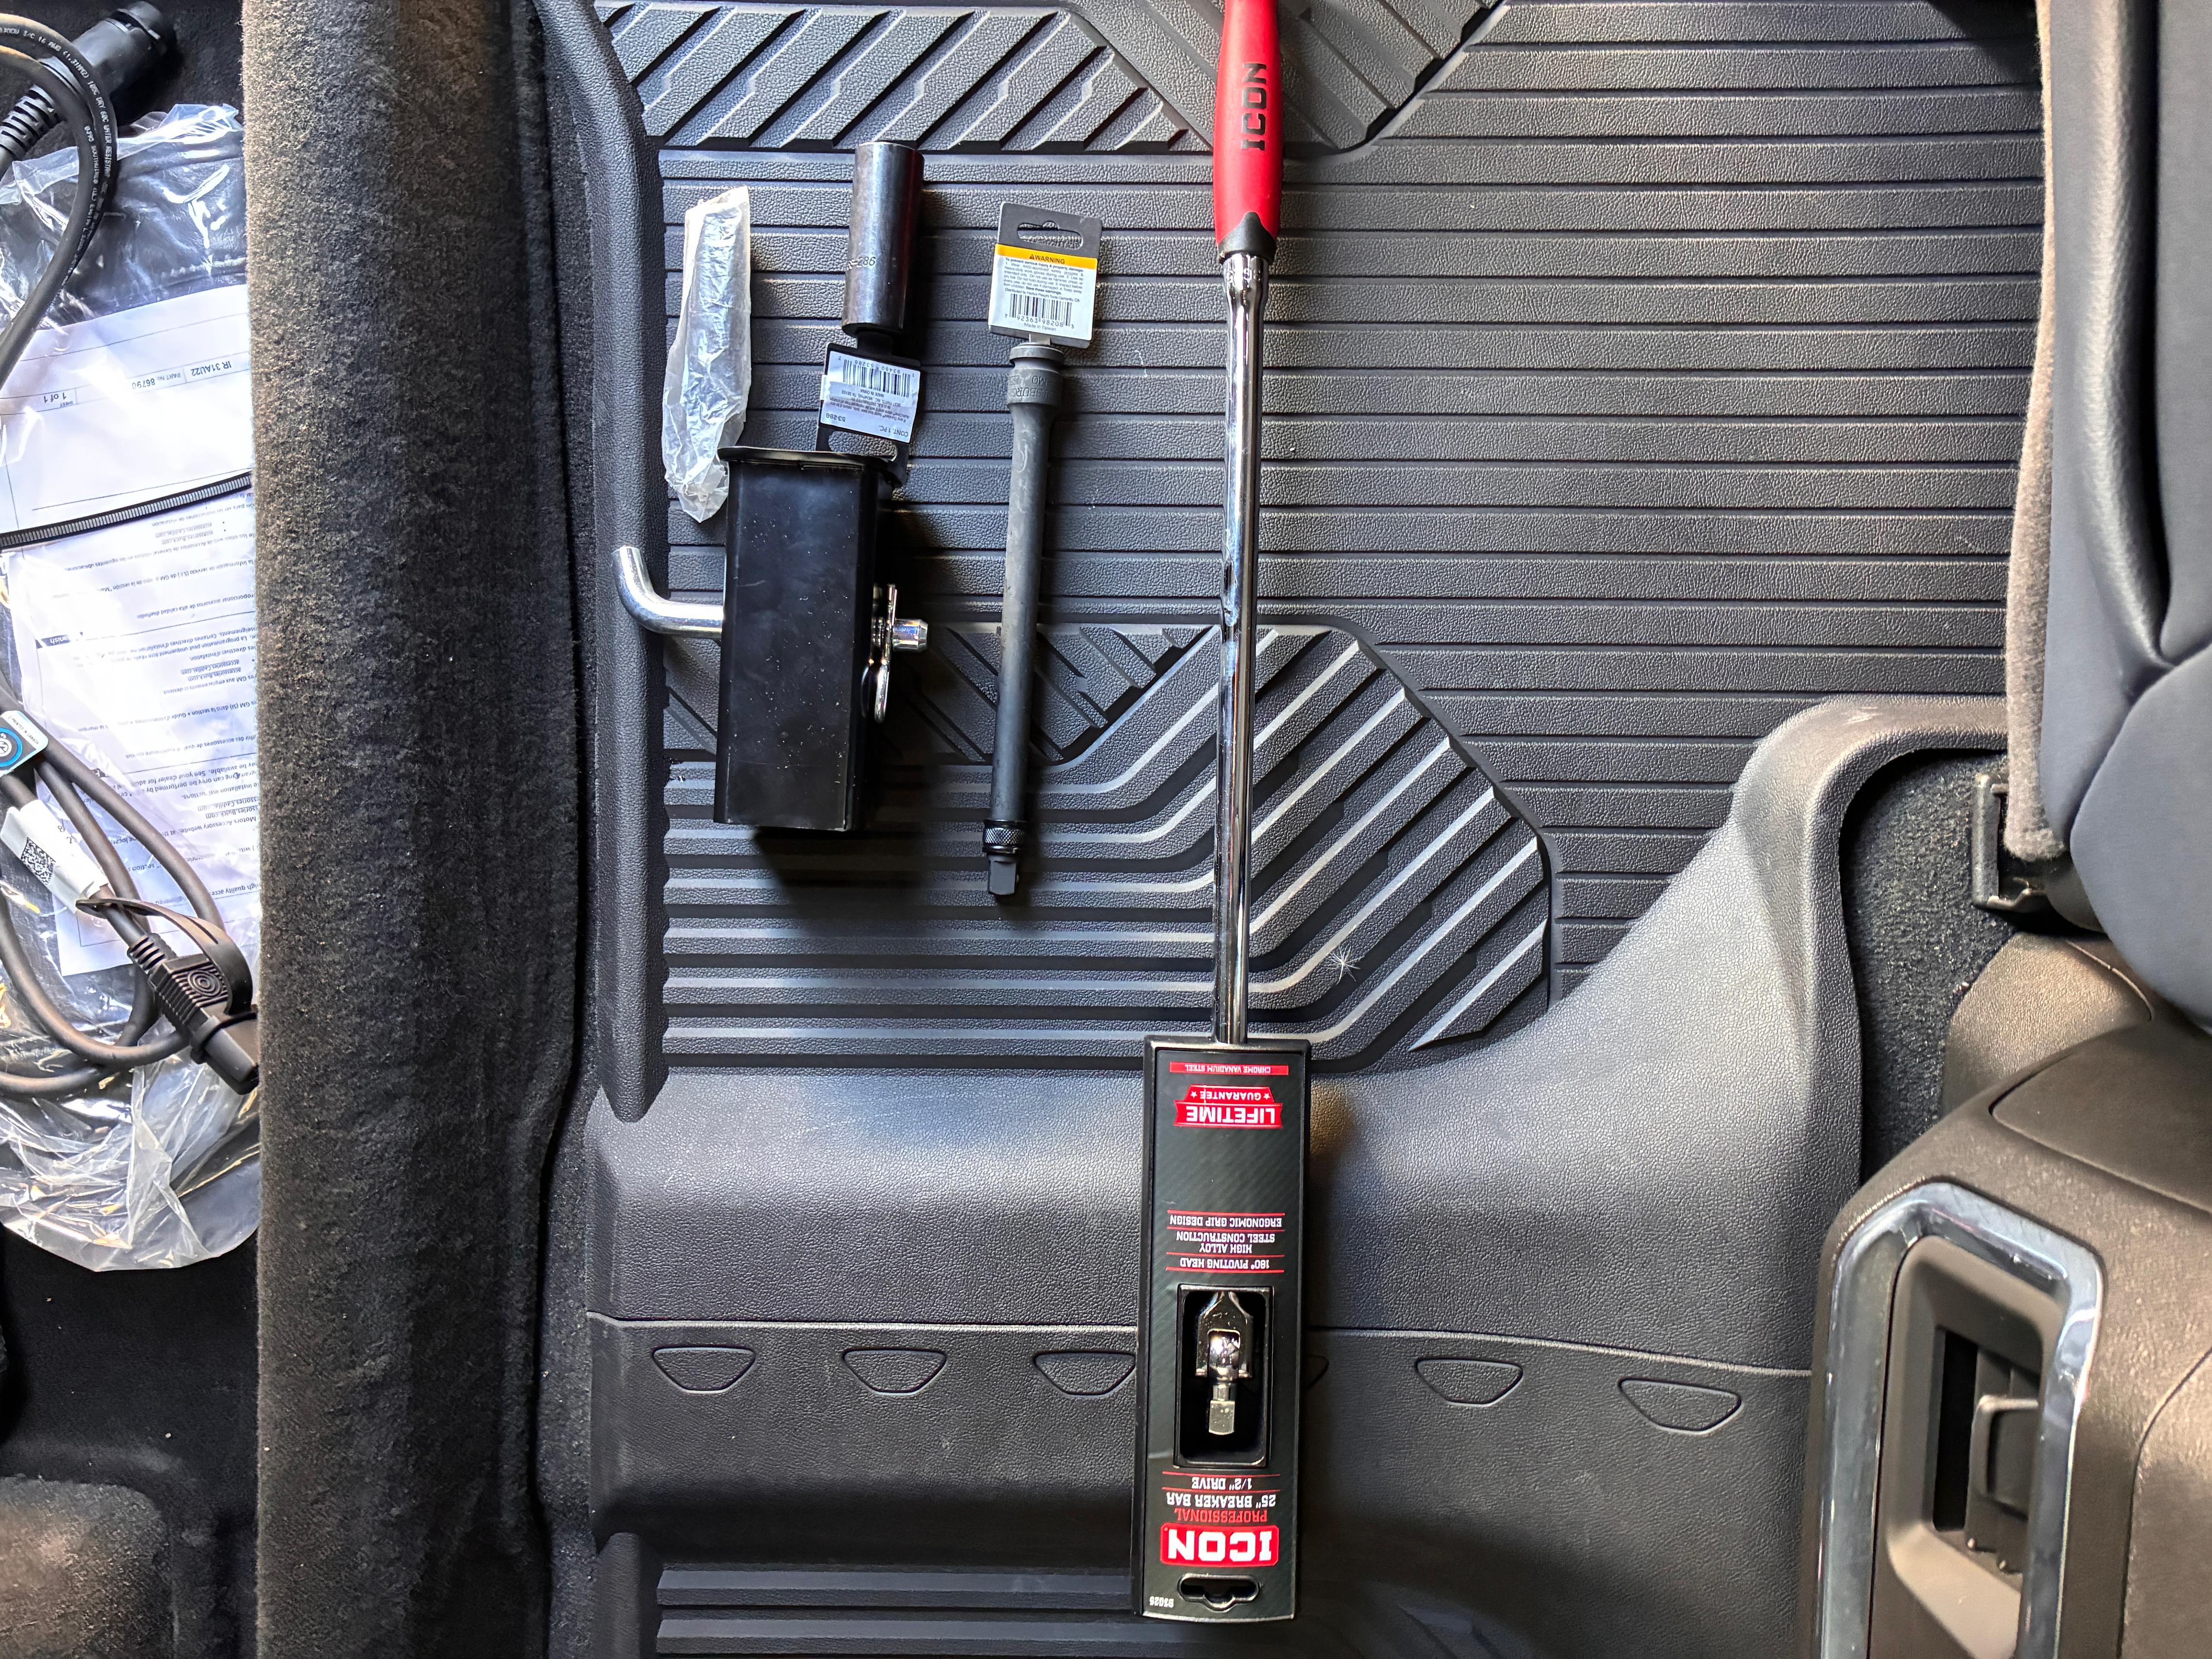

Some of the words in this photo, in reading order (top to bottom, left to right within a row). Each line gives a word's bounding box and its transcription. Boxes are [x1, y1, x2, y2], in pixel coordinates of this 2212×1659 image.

[1241, 63, 1268, 151] ICON
[1035, 255, 1065, 264] WARNING
[222, 360, 231, 369] IR
[854, 359, 874, 368] 53286
[190, 362, 220, 376] 31AU22
[165, 372, 181, 380] PART
[131, 378, 155, 389] 86790
[48, 393, 59, 402] of
[825, 413, 846, 422] 53-286
[892, 428, 909, 437] CONT.
[191, 708, 210, 716] section
[193, 769, 206, 778] See
[159, 775, 177, 784] dealer
[154, 781, 187, 792] performed
[219, 783, 252, 794] installation
[203, 819, 232, 830] Accessory
[234, 816, 256, 824] Motors
[225, 885, 245, 894] quality
[1199, 1091, 1261, 1100] GUARANTEE
[1185, 1106, 1275, 1123] LIFETIME
[1170, 1215, 1203, 1226] DESIGN
[1205, 1217, 1227, 1227] GRIP
[1229, 1217, 1282, 1228] ERGONOMIC
[1176, 1231, 1245, 1242] CONSTRUCTION
[1247, 1233, 1275, 1243] STEEL
[1199, 1243, 1227, 1253] ALLOY
[1230, 1243, 1252, 1253] HIGH
[1179, 1257, 1204, 1267] HEAD
[1206, 1258, 1248, 1269] PIVOTING
[1250, 1259, 1269, 1269] 180°
[1192, 1477, 1226, 1489] DRIVE
[1229, 1478, 1252, 1490] 1/2"
[1166, 1492, 1191, 1506] BAR
[1195, 1494, 1252, 1508] BREAKER
[1255, 1494, 1275, 1508] 25"
[1174, 1507, 1267, 1523] PROFESSIONAL
[1168, 1529, 1273, 1562] ICON
